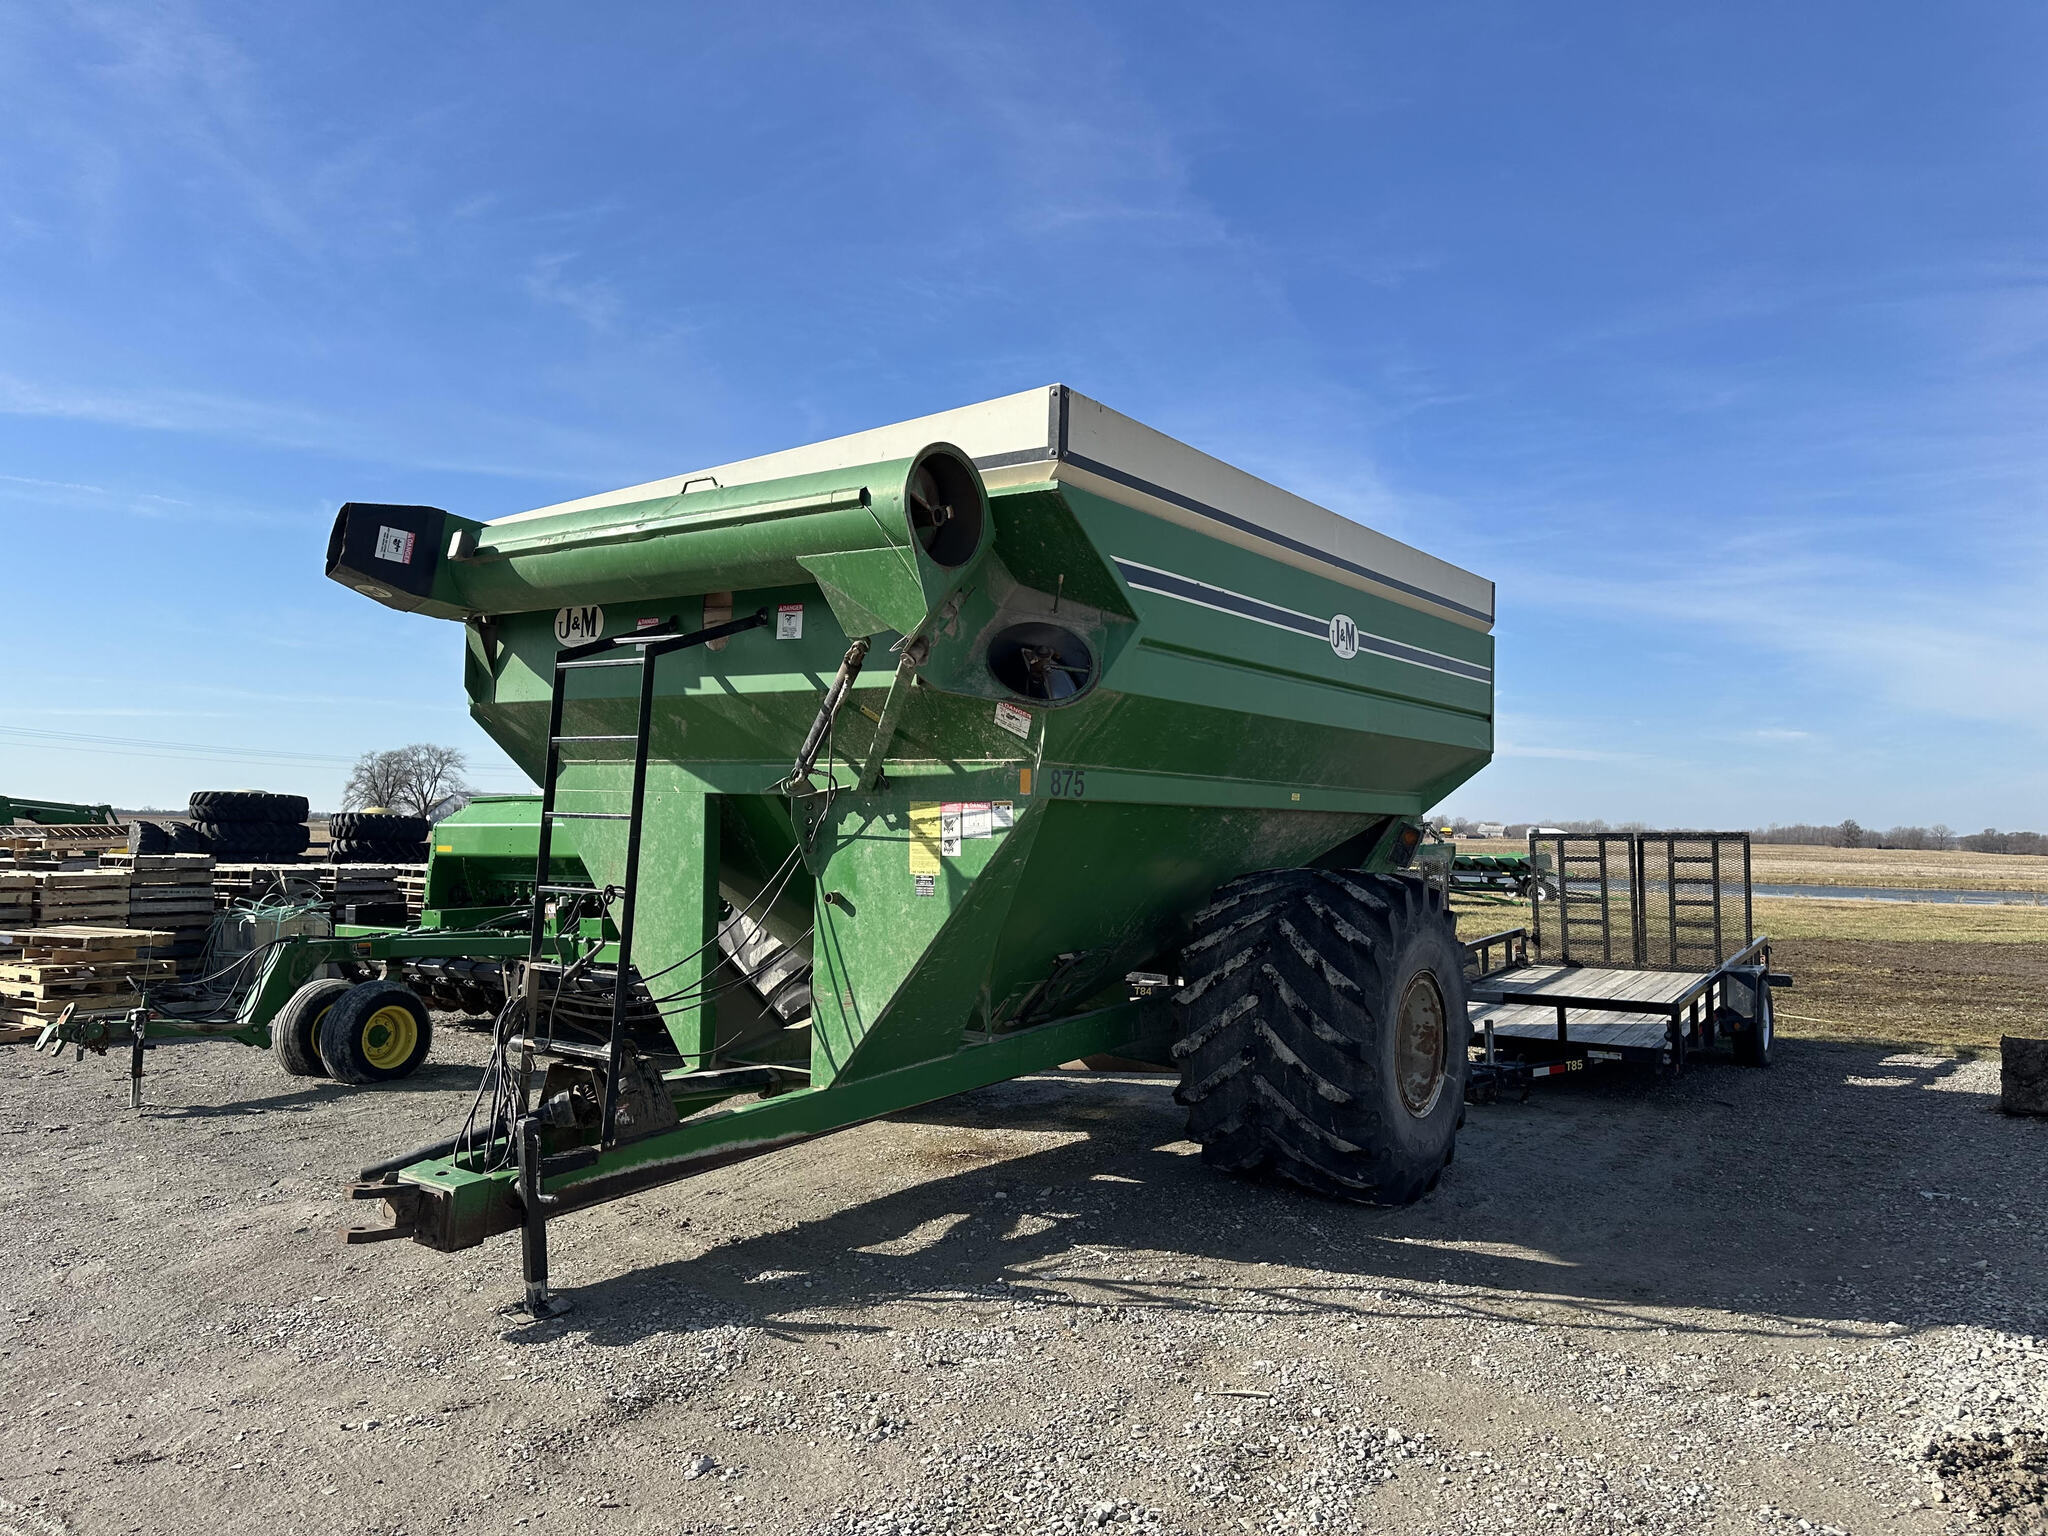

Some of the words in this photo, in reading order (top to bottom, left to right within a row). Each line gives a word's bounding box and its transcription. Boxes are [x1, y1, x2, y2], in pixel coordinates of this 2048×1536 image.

[558, 606, 598, 639] J&M
[1332, 619, 1355, 652] J&M
[1004, 703, 1031, 719] DANGER
[1050, 769, 1085, 798] 875
[1135, 986, 1152, 996] T84
[1566, 1059, 1583, 1071] T85
